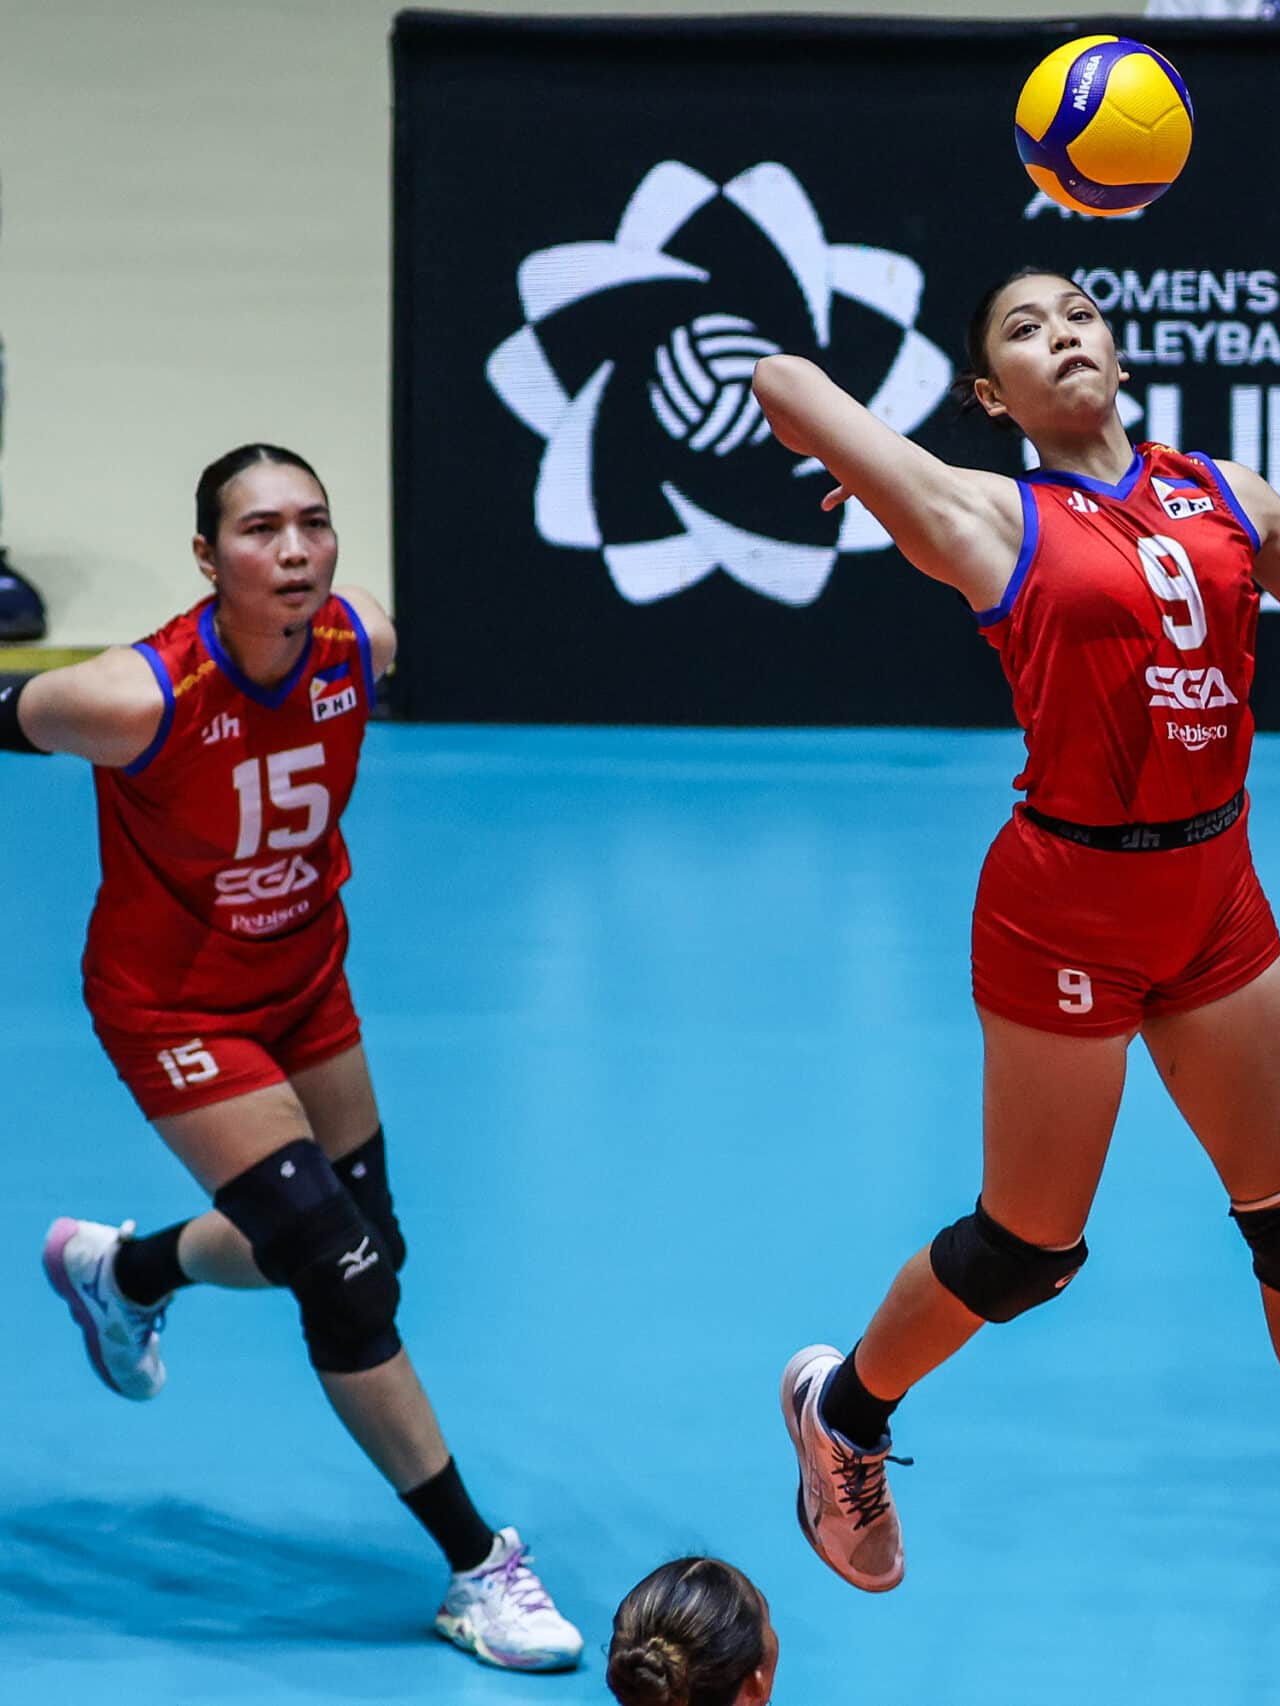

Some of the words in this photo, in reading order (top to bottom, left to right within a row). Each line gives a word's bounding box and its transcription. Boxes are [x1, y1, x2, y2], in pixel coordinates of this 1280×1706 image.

[1137, 534, 1208, 651] 9
[317, 692, 353, 717] PHI
[1145, 665, 1239, 710] SGA
[231, 742, 330, 860] 15
[214, 855, 319, 906] SGA
[1057, 968, 1093, 1014] 9
[157, 1038, 220, 1090] 15
